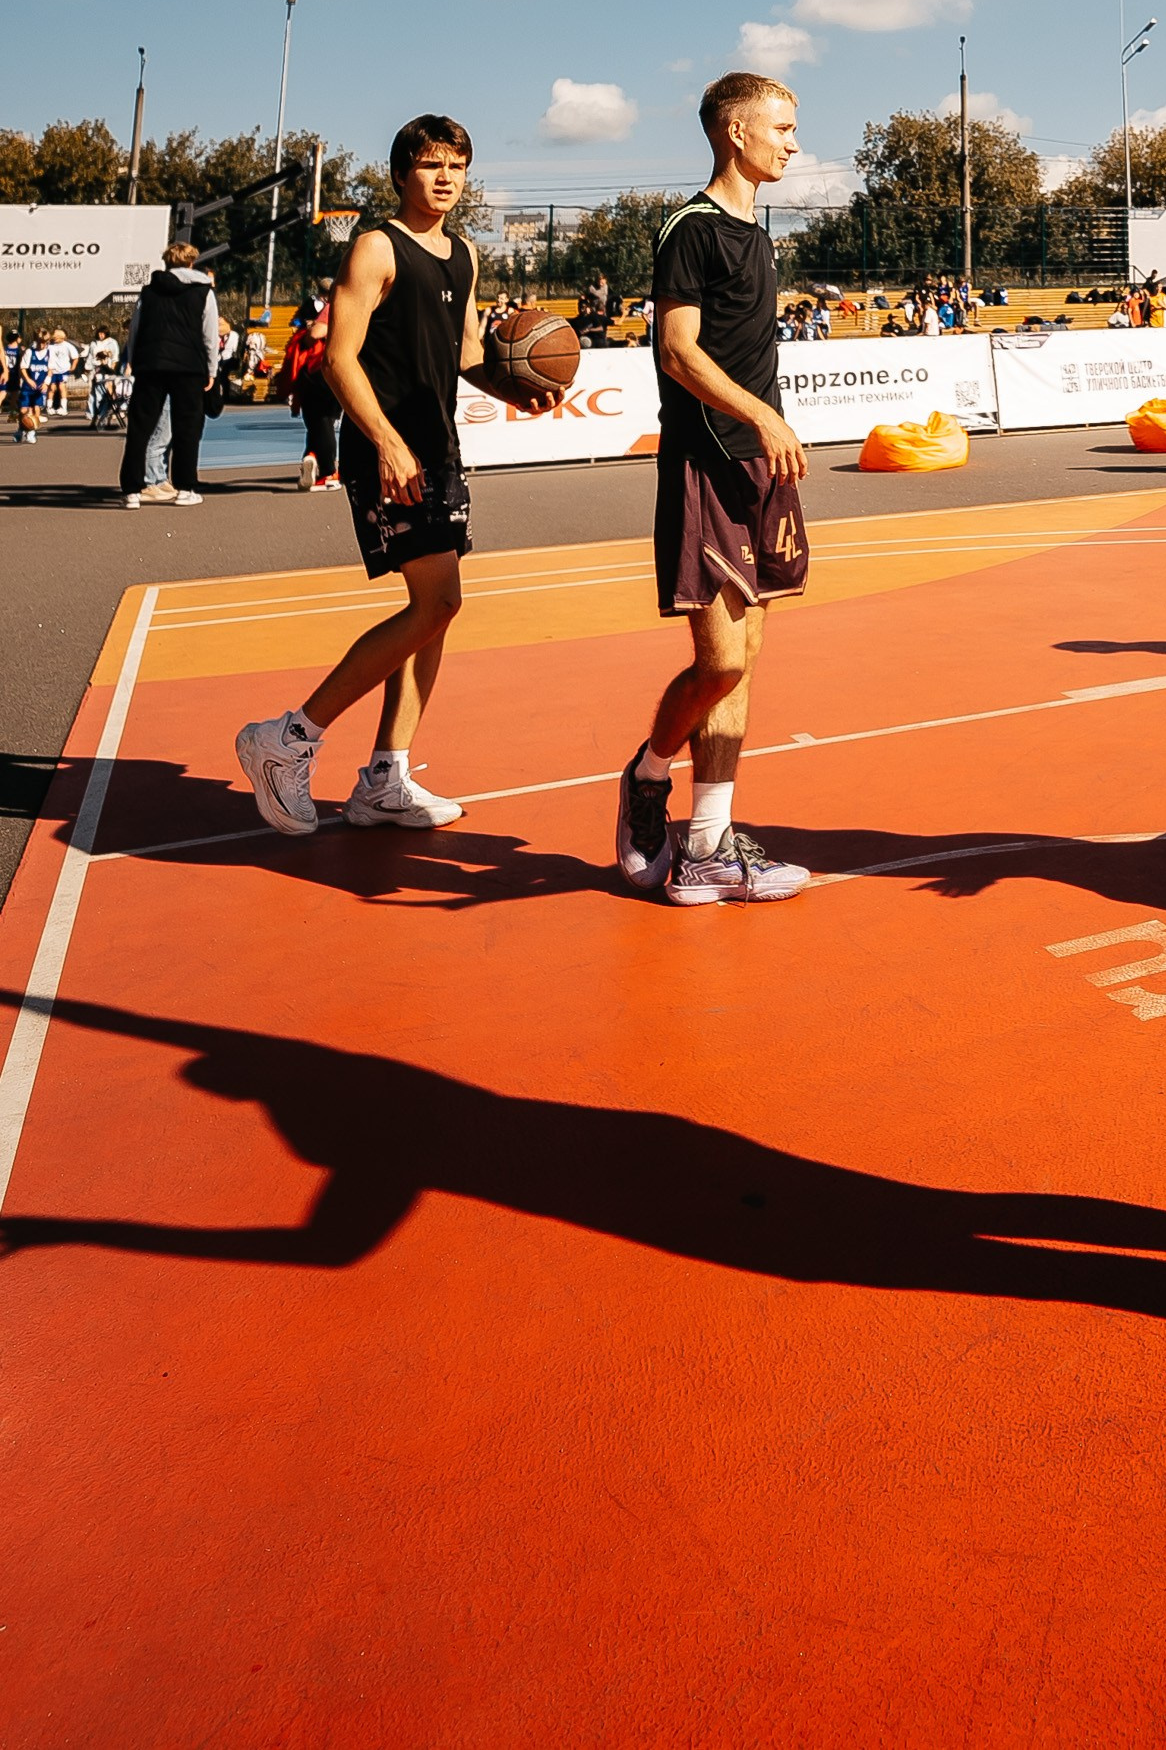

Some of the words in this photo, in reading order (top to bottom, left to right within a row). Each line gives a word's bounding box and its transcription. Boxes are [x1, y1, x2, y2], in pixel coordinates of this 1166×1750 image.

[1, 243, 100, 256] zone.co
[1084, 359, 1126, 376] ТВЕРСКОЙ
[777, 368, 929, 394] appzone.co
[1086, 376, 1129, 391] УЛИЧНОГО
[797, 394, 856, 408] магазин
[859, 391, 914, 404] техники
